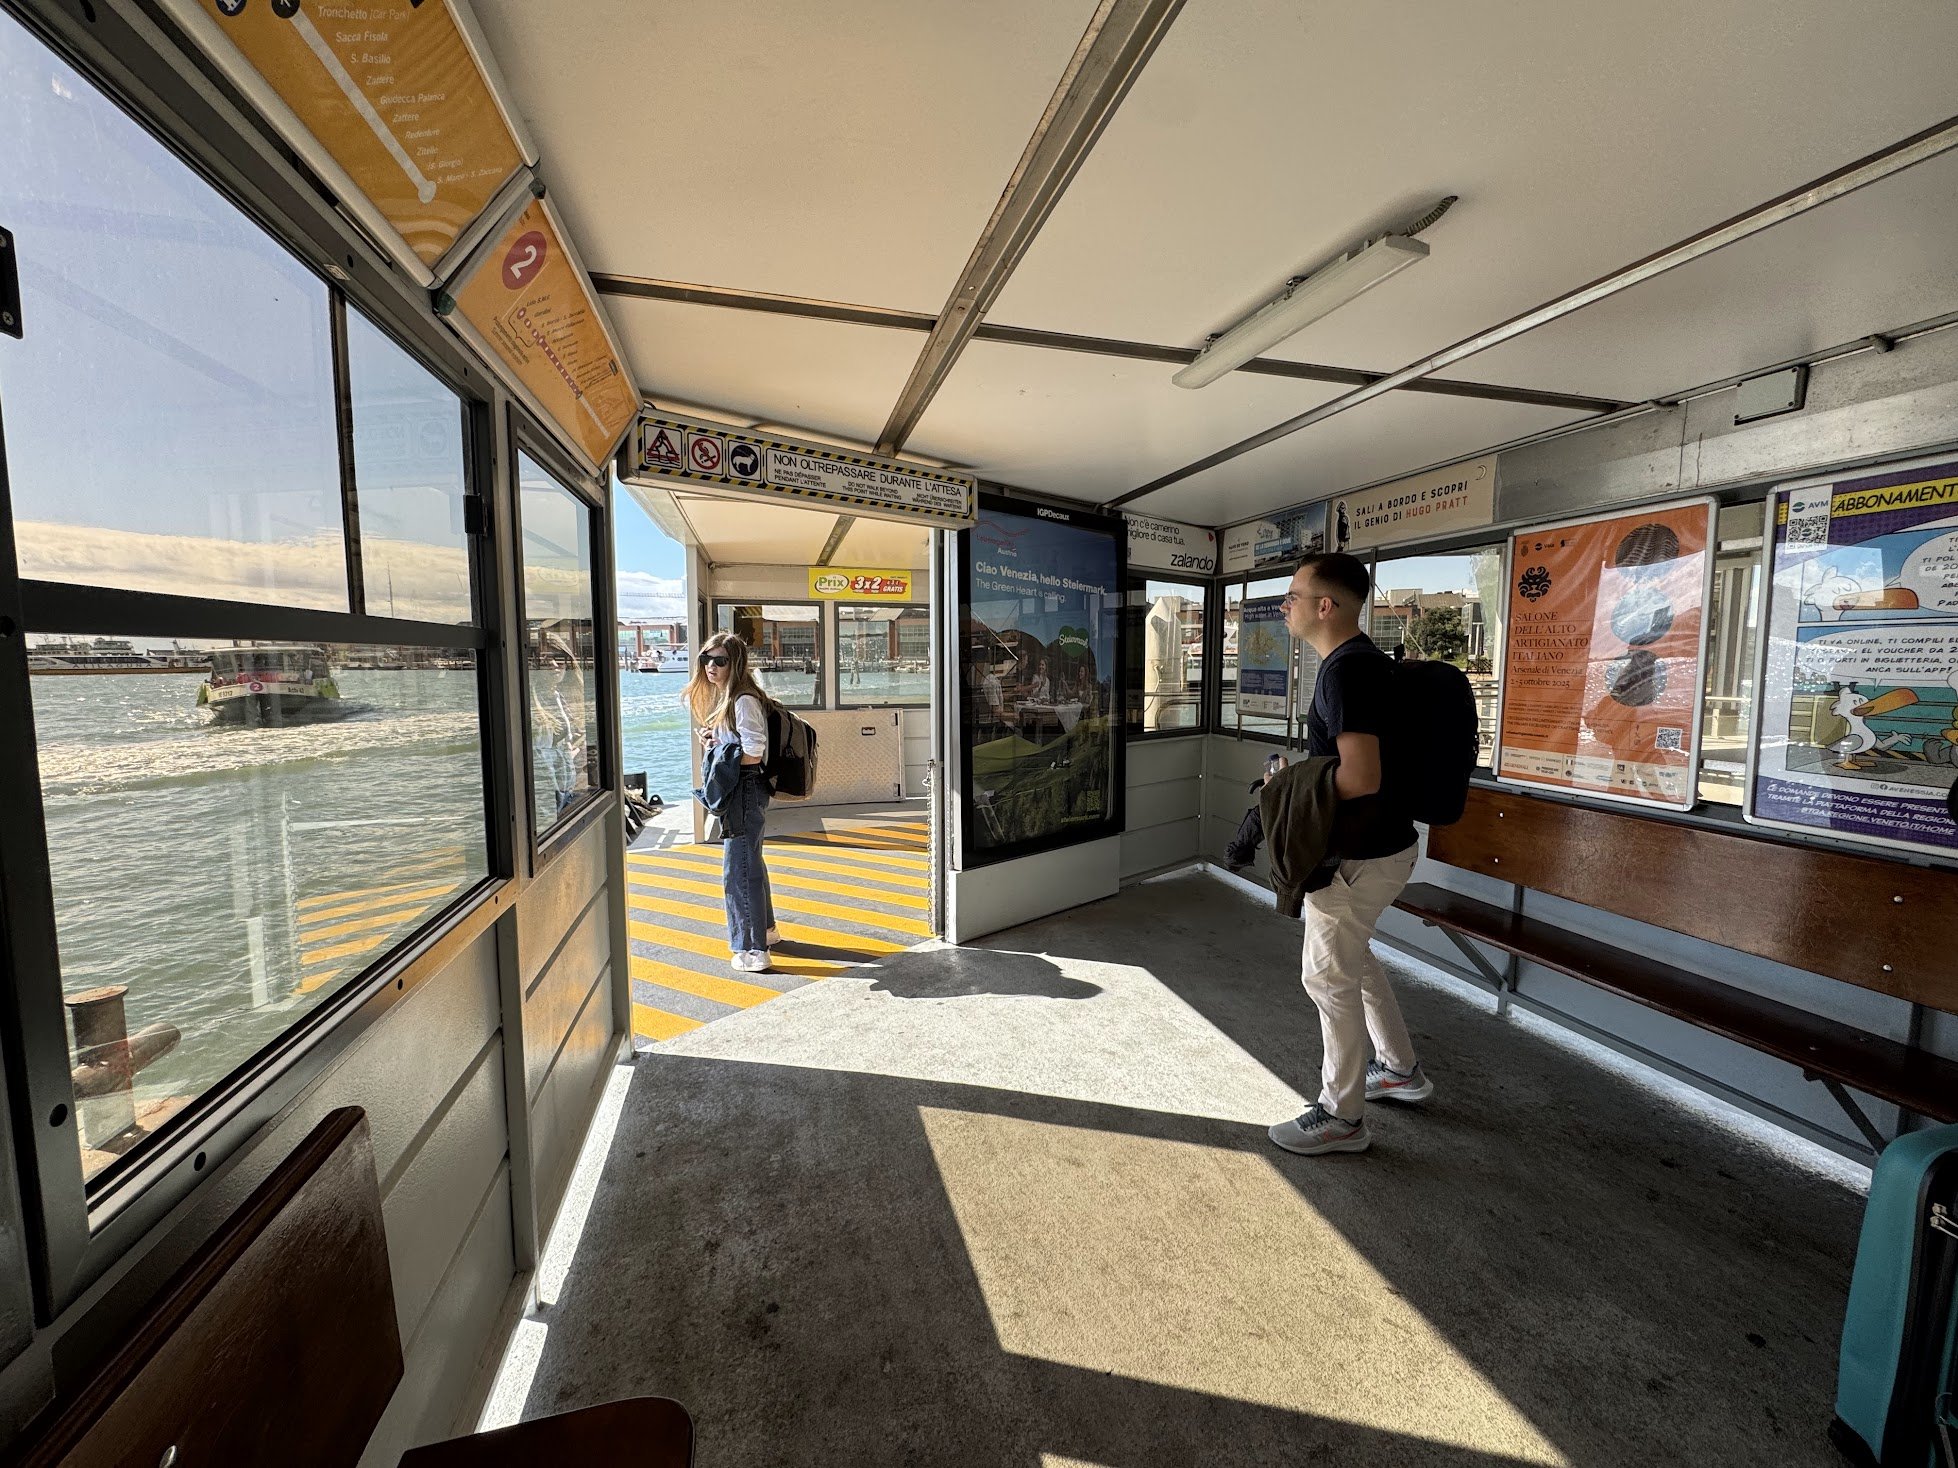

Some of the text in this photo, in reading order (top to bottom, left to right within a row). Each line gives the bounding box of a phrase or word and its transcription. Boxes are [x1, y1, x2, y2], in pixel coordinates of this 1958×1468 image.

[318, 6, 367, 19] Tronchetto
[336, 31, 388, 42] Sacca Fisola
[351, 53, 391, 64] S. Basilio
[366, 75, 394, 85] Zattere
[510, 245, 537, 279] 2
[773, 453, 962, 497] NON OLTREPASSARE DURANTE L'ATTESA
[774, 474, 799, 484] PENDANT
[854, 487, 868, 495] POINT
[1356, 480, 1468, 517] SALI A BORDO E SCOPRI
[1808, 500, 1829, 509] AVM
[1037, 507, 1070, 521] IGPDecaux
[1354, 495, 1468, 530] IL GENIO DI HUGO PRATT
[1140, 519, 1150, 529] c'è
[1151, 531, 1157, 541] di
[1157, 534, 1172, 543] casa
[1170, 552, 1214, 571] zalando
[854, 575, 882, 590] 3x2
[975, 561, 1108, 596] Ciao Venezia, hello Steiermark.
[975, 578, 990, 589] The
[991, 580, 1015, 593] Green
[1016, 586, 1037, 597] Heart
[1044, 591, 1065, 603] calling
[1515, 611, 1558, 621] SALONE
[1513, 637, 1589, 648] ARTIGIANATO
[1512, 651, 1564, 661] ITALIANO
[1511, 665, 1583, 675] Arsenale di Venezia
[1523, 677, 1550, 687] ottobre
[1552, 680, 1570, 688] 2025
[1778, 786, 1821, 798] DOMANDE
[1821, 792, 1860, 803] DEVONO
[1860, 797, 1900, 808] ESSERE
[1767, 793, 1801, 804] TRAMITE
[1802, 798, 1814, 806] LA
[1814, 800, 1878, 815] PIATTAFORMA
[1879, 809, 1910, 819] DELLA
